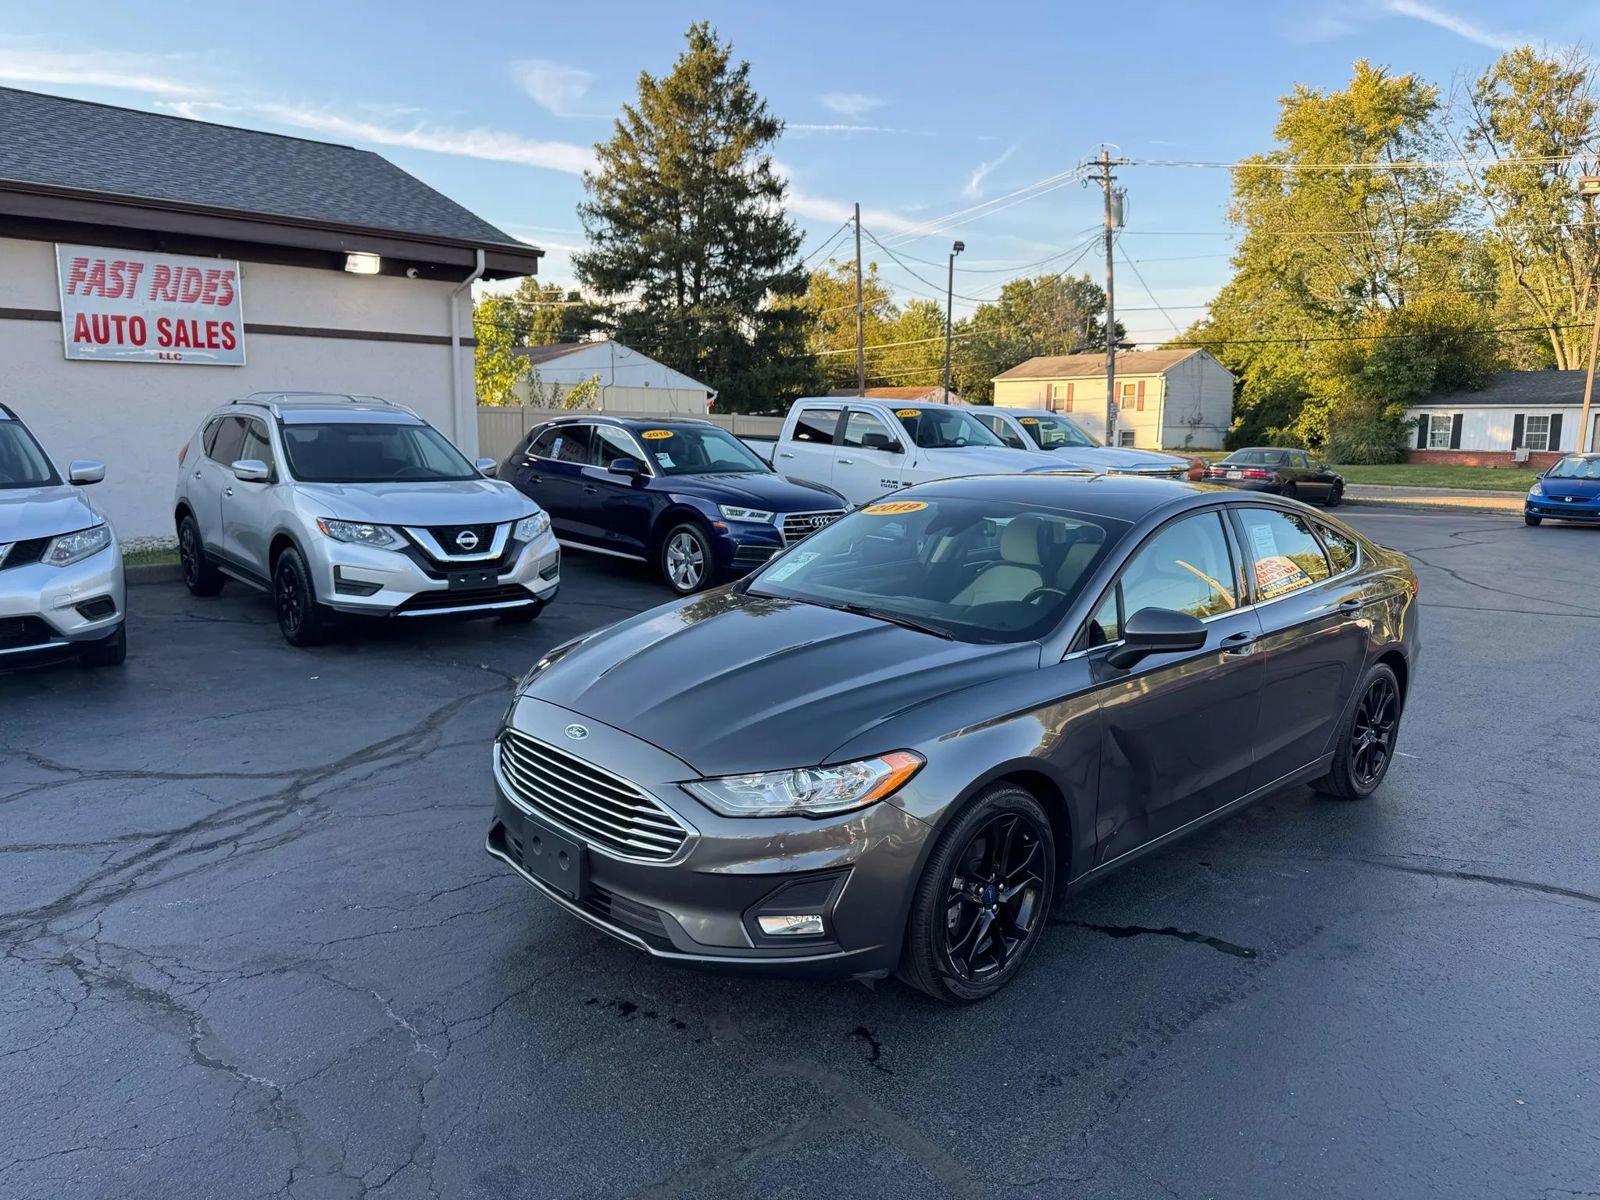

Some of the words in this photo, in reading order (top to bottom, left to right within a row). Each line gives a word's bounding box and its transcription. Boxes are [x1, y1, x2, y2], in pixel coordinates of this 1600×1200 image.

[66, 257, 145, 299] FAST
[149, 265, 236, 306] RIDES
[73, 313, 147, 346] AUTO
[157, 317, 236, 350] SALES
[159, 352, 182, 360] LLC
[866, 503, 923, 513] 2019
